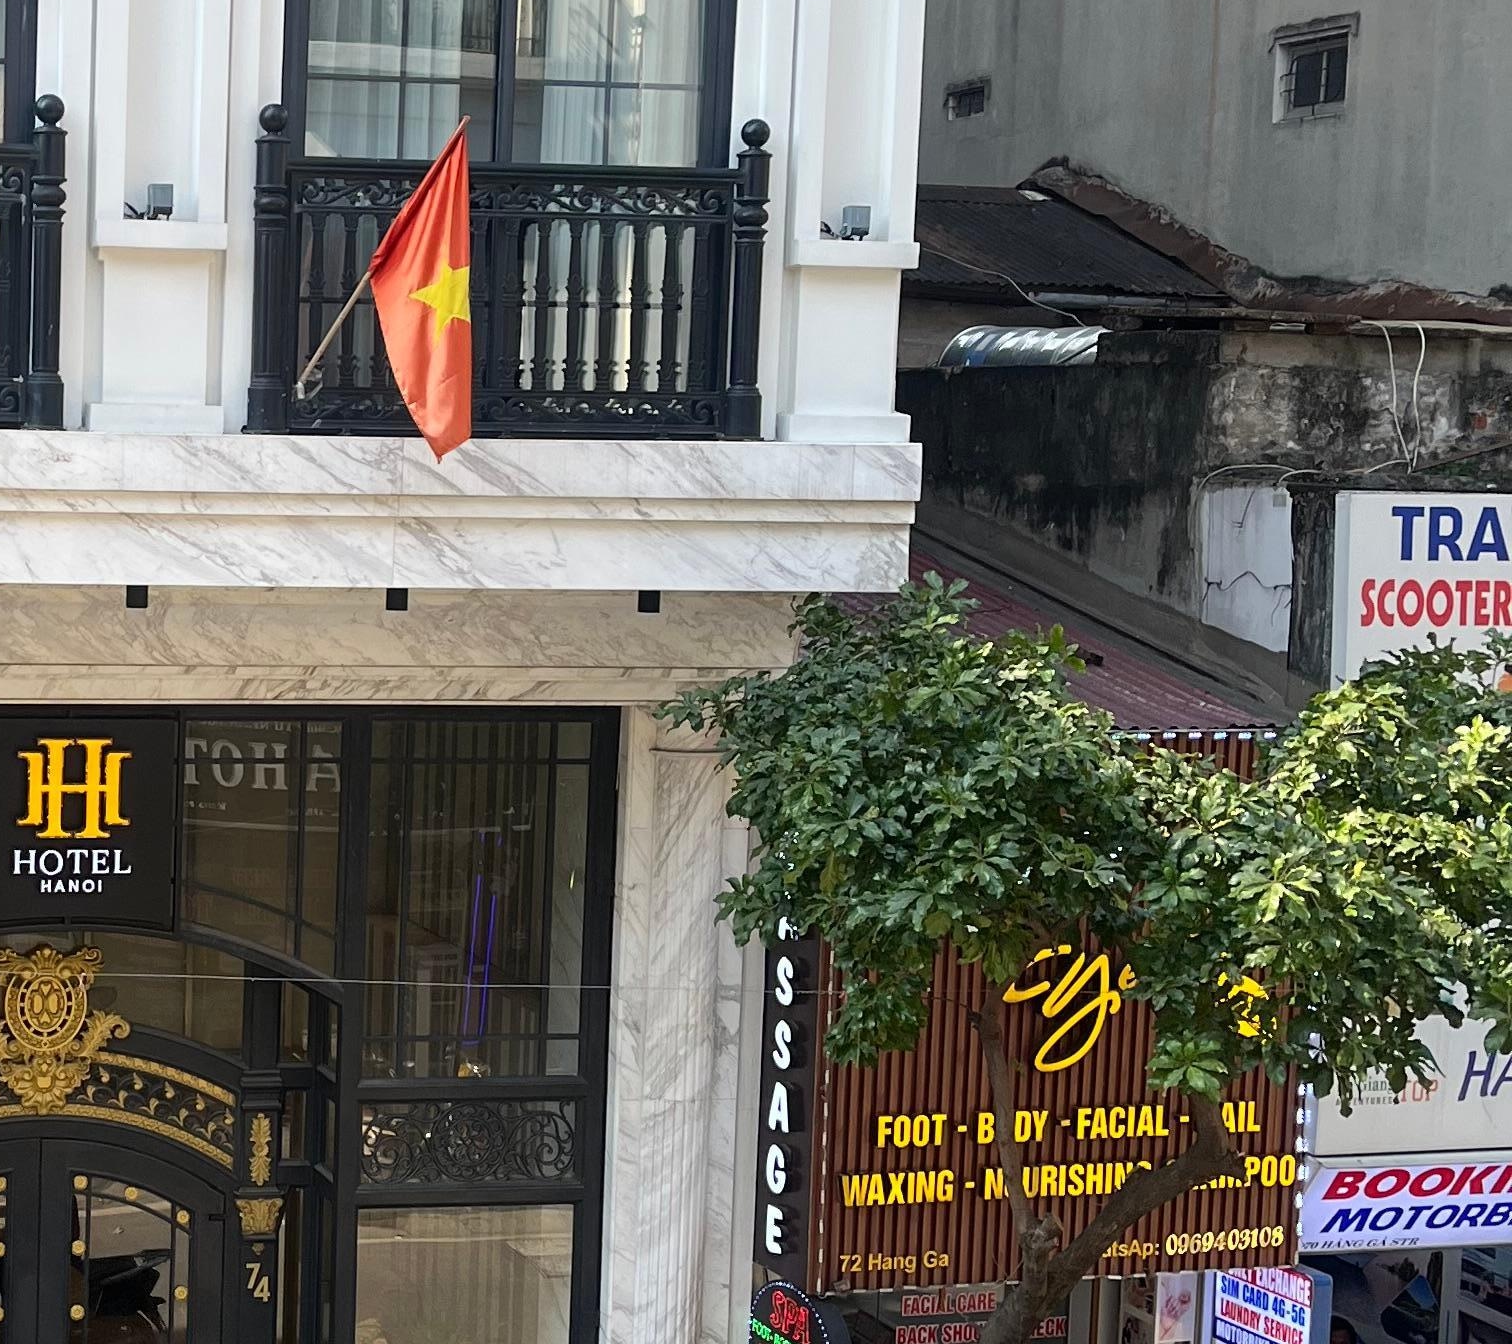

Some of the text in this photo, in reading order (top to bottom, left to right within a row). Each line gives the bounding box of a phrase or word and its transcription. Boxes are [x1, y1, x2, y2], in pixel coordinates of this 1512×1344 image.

[1391, 506, 1511, 562] TRA
[1360, 578, 1512, 627] SCOOTER
[12, 848, 132, 876] HOTEL
[39, 878, 104, 893] HANOI
[764, 916, 797, 1256] ASSAGE
[876, 1113, 948, 1149] FOOT
[976, 1109, 1049, 1145] BDY
[1076, 1105, 1170, 1141] FACIAL
[1219, 1101, 1261, 1133] AIL
[840, 1168, 955, 1208] WAXING
[1322, 1165, 1512, 1201] BOOKI
[1320, 1202, 1512, 1234] MOTORB
[839, 1254, 863, 1273] 72
[867, 1252, 917, 1275] Hang
[923, 1251, 950, 1270] Ga
[1165, 1225, 1285, 1257] 0969403108
[245, 1262, 272, 1303] 74
[1220, 1275, 1240, 1300] SIM
[1242, 1283, 1269, 1311] CARD
[902, 1291, 997, 1317] FACIAL CARE
[1220, 1297, 1261, 1331] LAUNDRY
